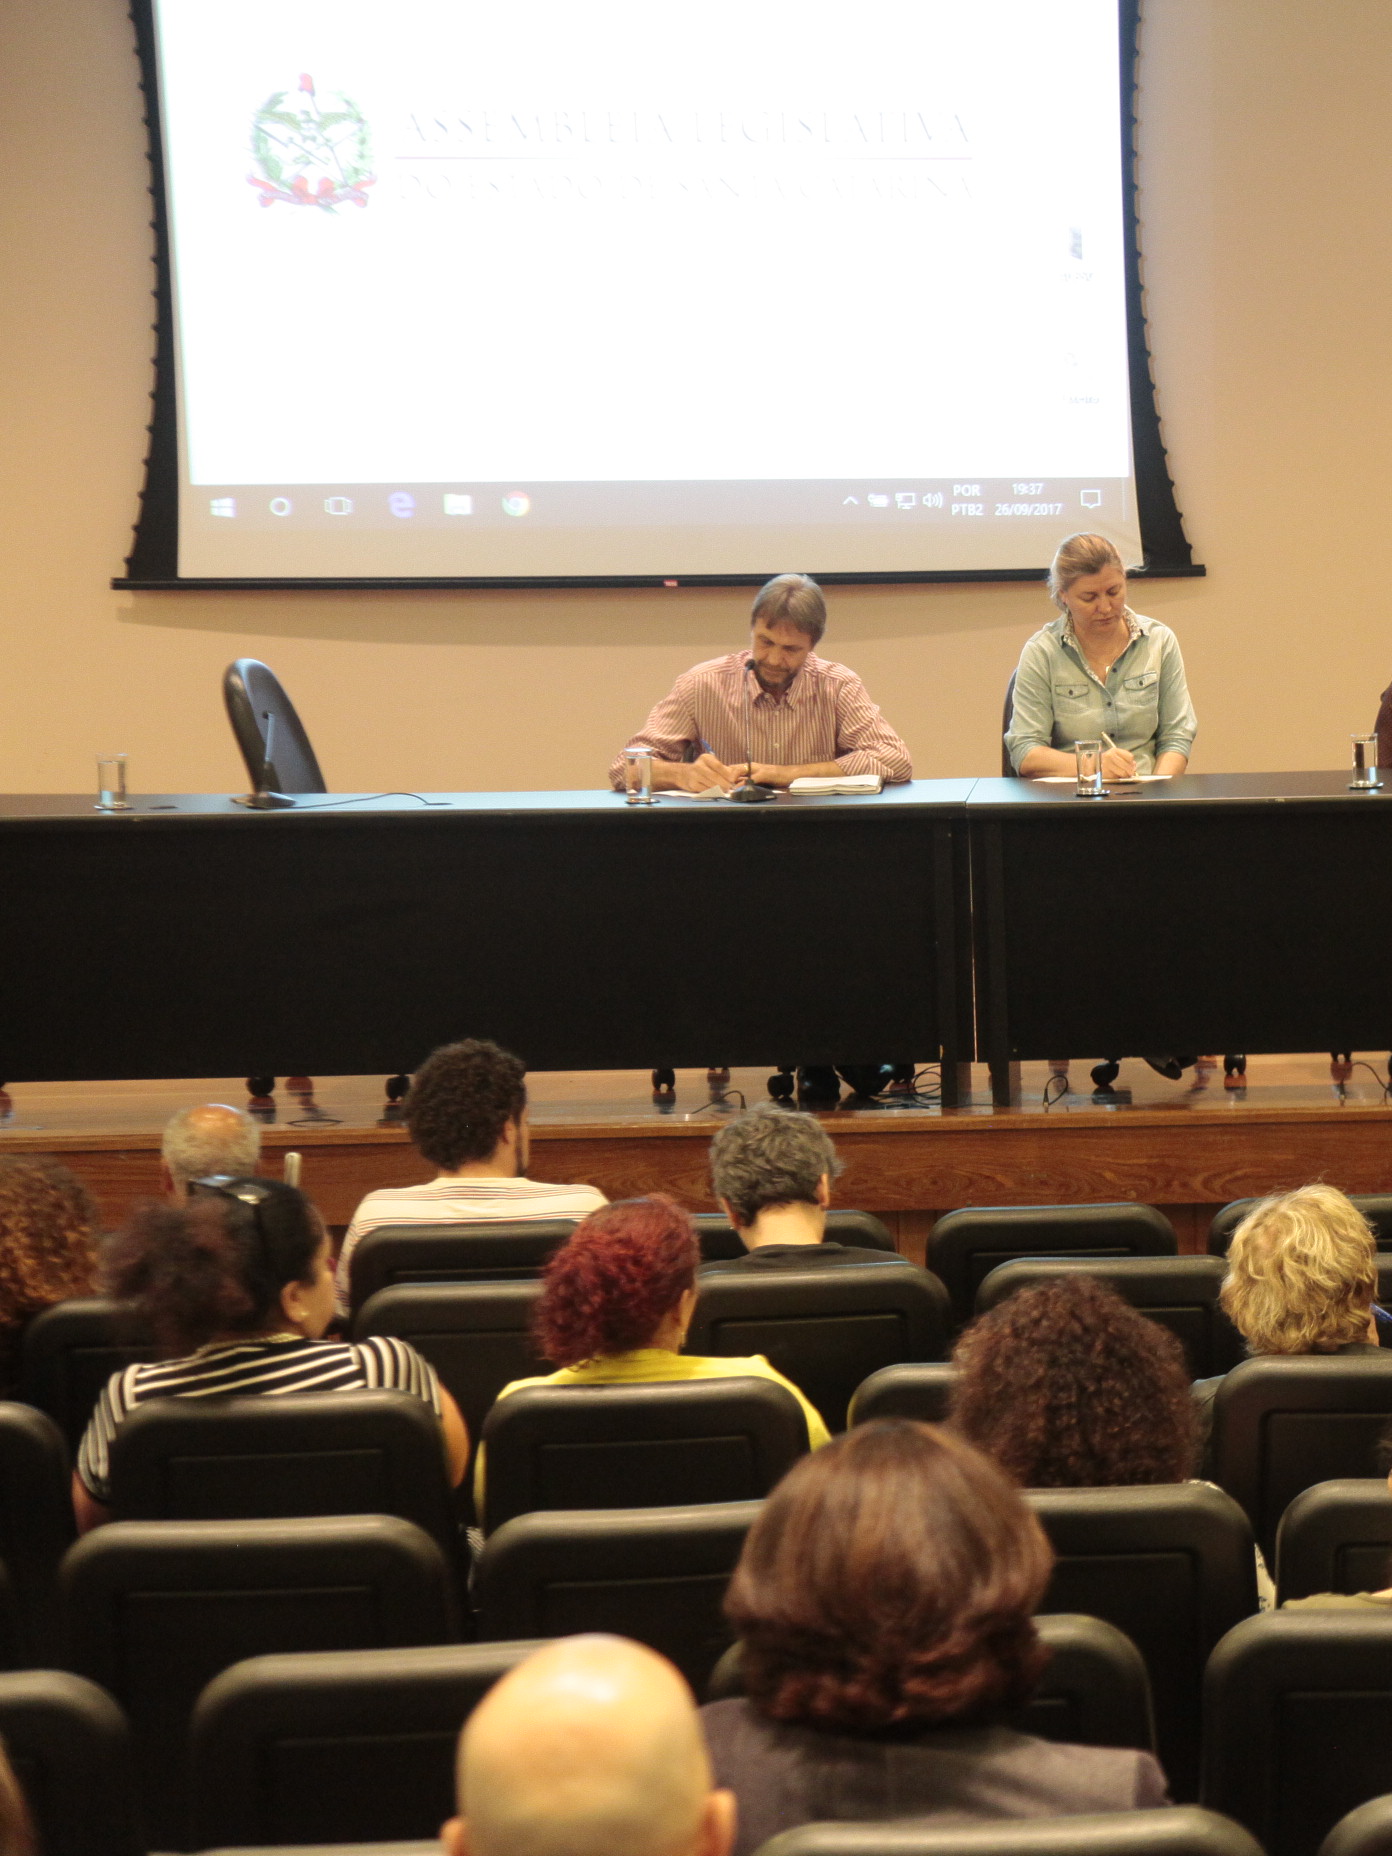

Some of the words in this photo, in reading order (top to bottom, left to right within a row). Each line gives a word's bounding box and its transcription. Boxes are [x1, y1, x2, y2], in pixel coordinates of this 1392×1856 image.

[953, 483, 981, 497] POR
[1012, 483, 1044, 495] 19:37
[951, 503, 983, 516] PTB2
[995, 502, 1062, 517] 26/09/2017
